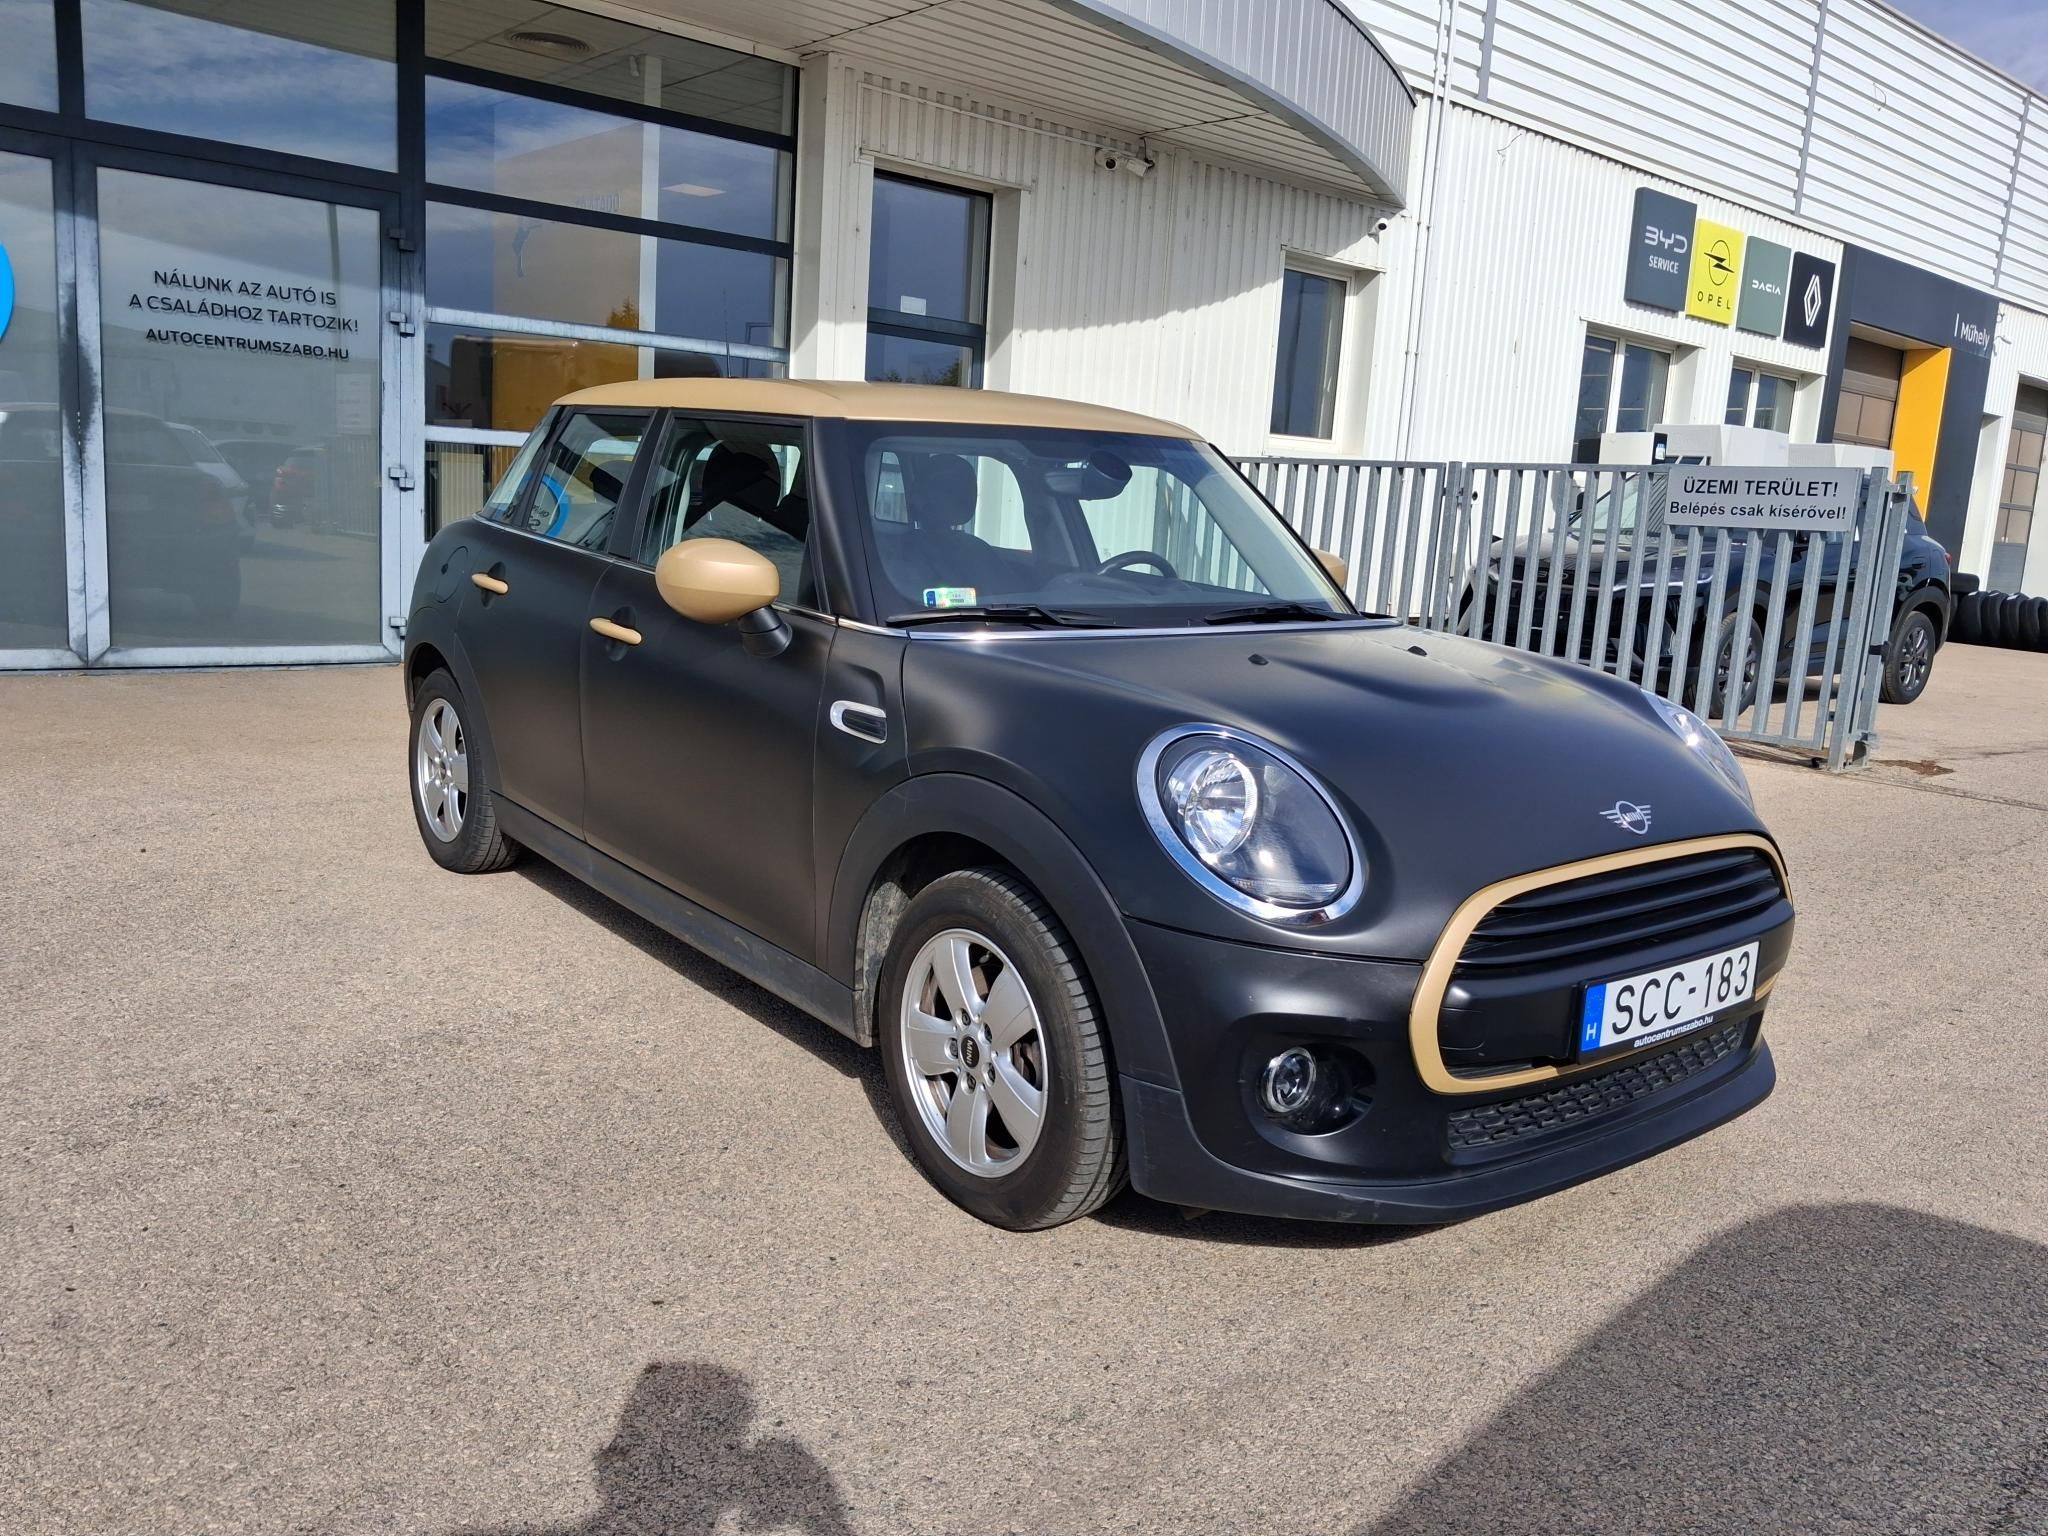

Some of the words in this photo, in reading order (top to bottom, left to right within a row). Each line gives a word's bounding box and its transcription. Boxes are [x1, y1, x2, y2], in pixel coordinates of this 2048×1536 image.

[1644, 225, 1688, 254] BYD
[1648, 255, 1680, 274] SERVICE
[153, 268, 233, 293] NÁLUNK
[238, 281, 262, 297] AZ
[266, 284, 317, 303] AUTÓ
[321, 291, 337, 306] IS
[1696, 291, 1731, 310] OPEL
[1751, 279, 1782, 296] DACIA
[129, 293, 142, 309] A
[147, 295, 264, 321] CSALÁDHOZ
[266, 309, 359, 333] TARTOZIK!
[145, 328, 349, 360] AUTOCENTRUMSZABO.HU
[1960, 322, 1991, 351] Műhely
[1683, 476, 1739, 495] ÜZEMI
[1745, 477, 1839, 498] TERÜLET!
[1669, 501, 1726, 518] Belépés
[1730, 504, 1764, 517] csak
[1769, 504, 1847, 519] kísérővel!
[1611, 950, 1751, 1035] SCC-183
[1585, 1022, 1598, 1041] H
[1633, 1015, 1714, 1049] autocentrumszabo.hu
